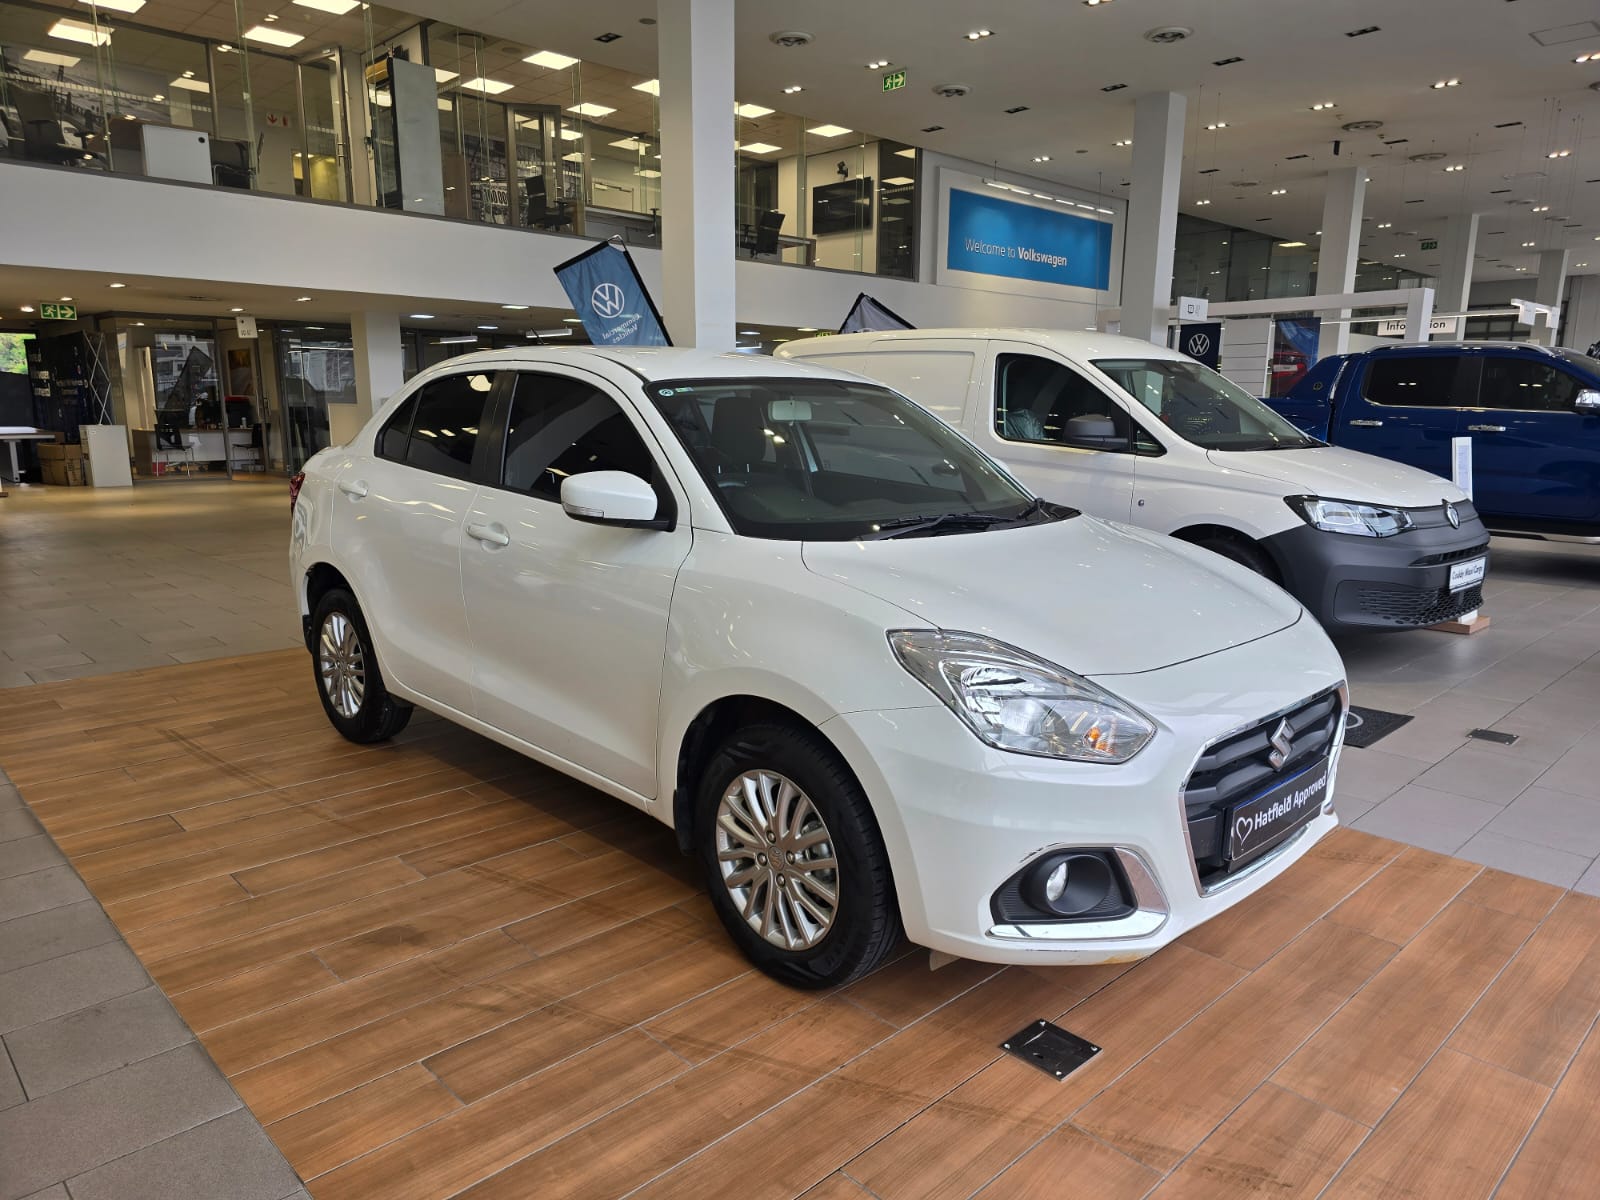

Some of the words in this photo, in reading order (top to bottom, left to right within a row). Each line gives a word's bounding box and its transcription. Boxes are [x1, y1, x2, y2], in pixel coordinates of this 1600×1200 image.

[965, 239, 1005, 257] Welcome
[1007, 246, 1016, 258] to
[1017, 246, 1067, 267] Volkswagen
[1386, 320, 1446, 331] Infoion
[1254, 794, 1292, 830] Hatfield
[1293, 770, 1328, 808] Approved
